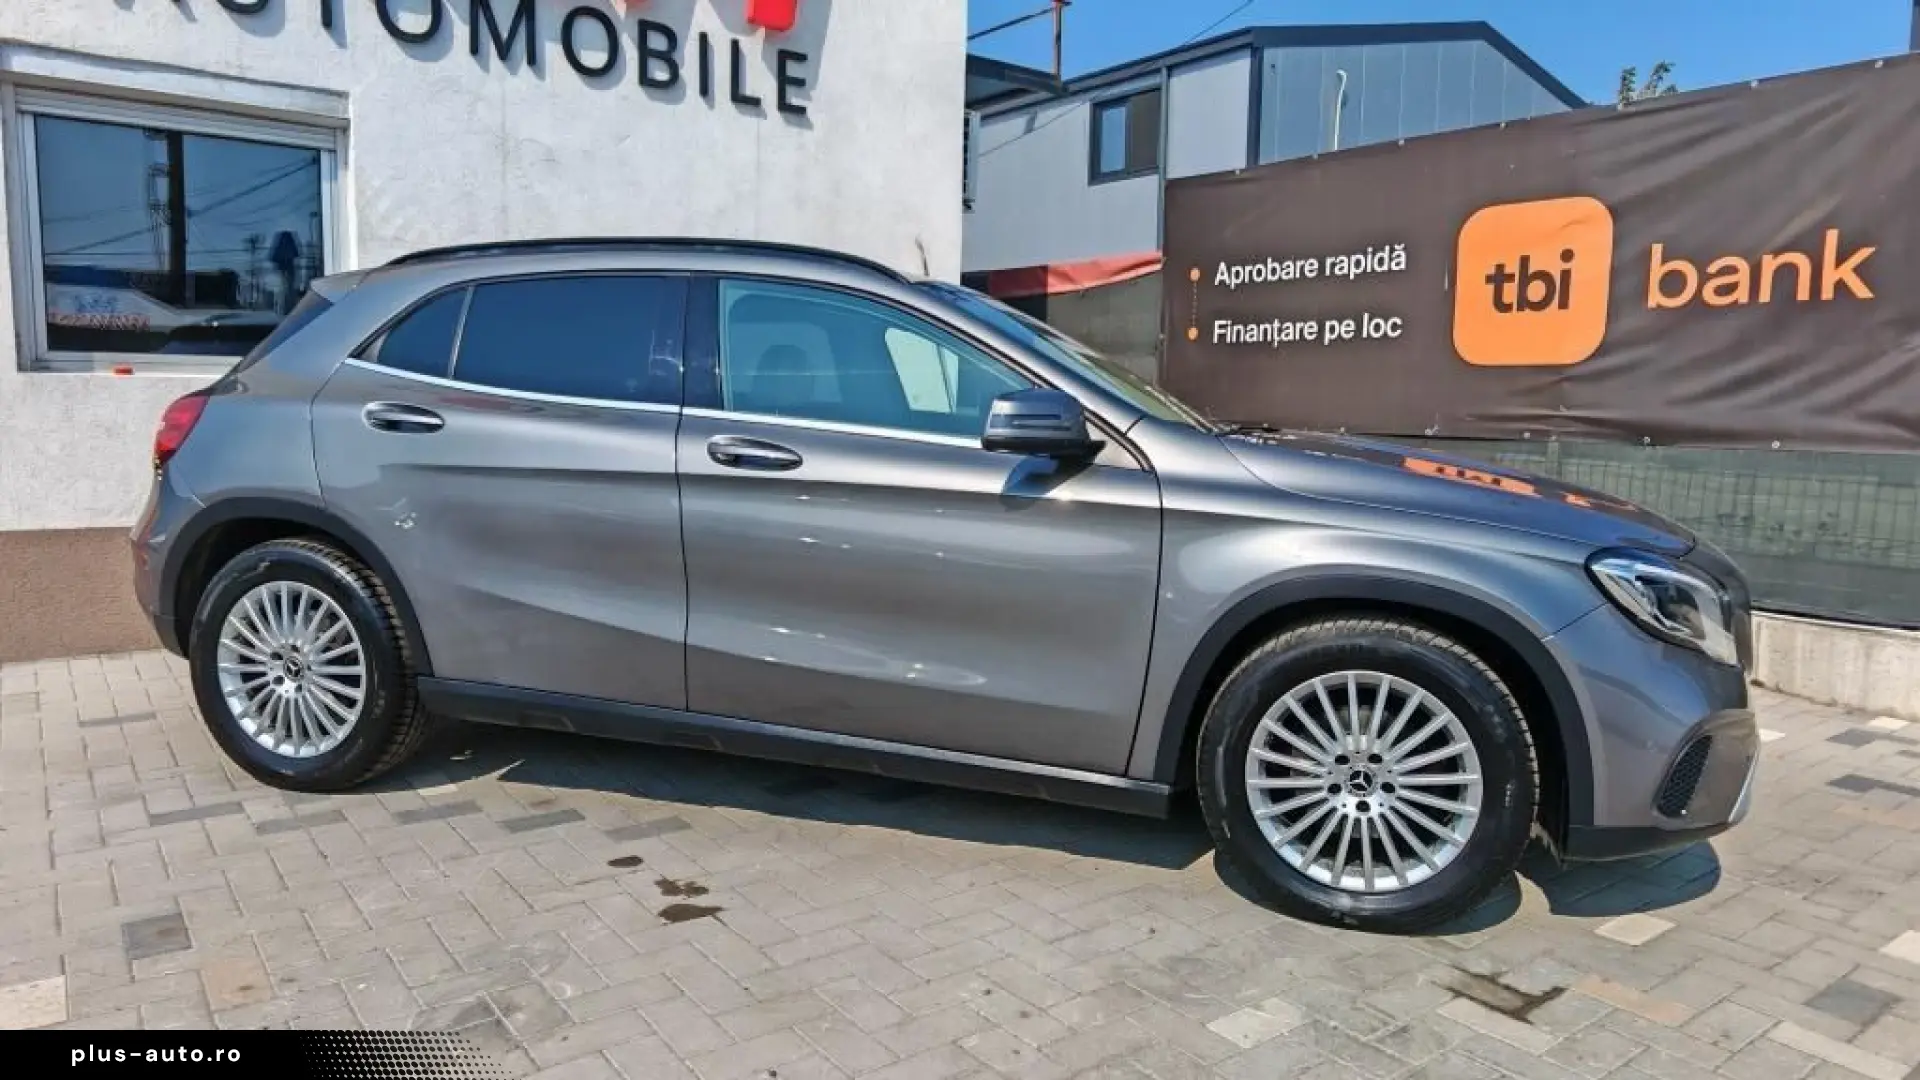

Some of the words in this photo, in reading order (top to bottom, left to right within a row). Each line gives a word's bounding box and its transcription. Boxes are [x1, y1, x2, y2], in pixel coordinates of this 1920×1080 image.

[171, 0, 808, 115] OMOBILE
[1214, 256, 1319, 290] Aprobare
[1325, 243, 1407, 280] rapidă
[1484, 248, 1575, 314] tbi
[1646, 228, 1878, 310] bank
[1212, 317, 1319, 349] Finanțare
[1323, 318, 1356, 346] pe
[1362, 311, 1403, 339] loc
